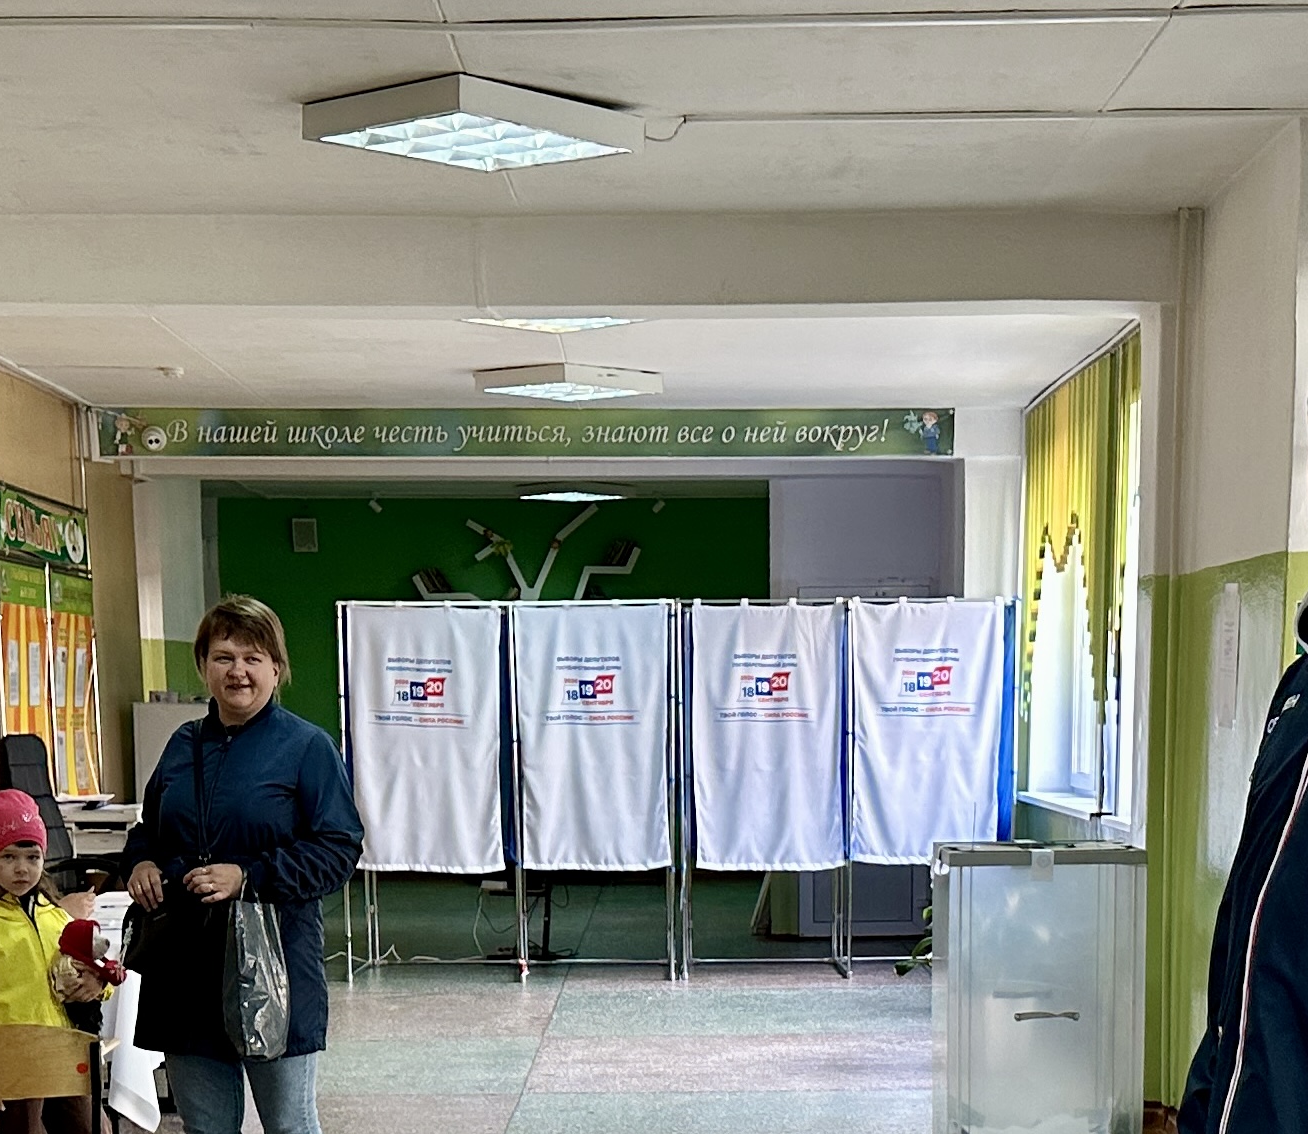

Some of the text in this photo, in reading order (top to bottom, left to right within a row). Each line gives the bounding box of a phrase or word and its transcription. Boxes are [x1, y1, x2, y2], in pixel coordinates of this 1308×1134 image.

[167, 418, 889, 452] В нашей школе честь учиться, знают все о ней вокруг!
[396, 681, 442, 701] 18 19 20
[566, 679, 611, 700] 18 19 20
[742, 676, 787, 697] 18 19 20
[903, 670, 949, 692] 18 19 20
